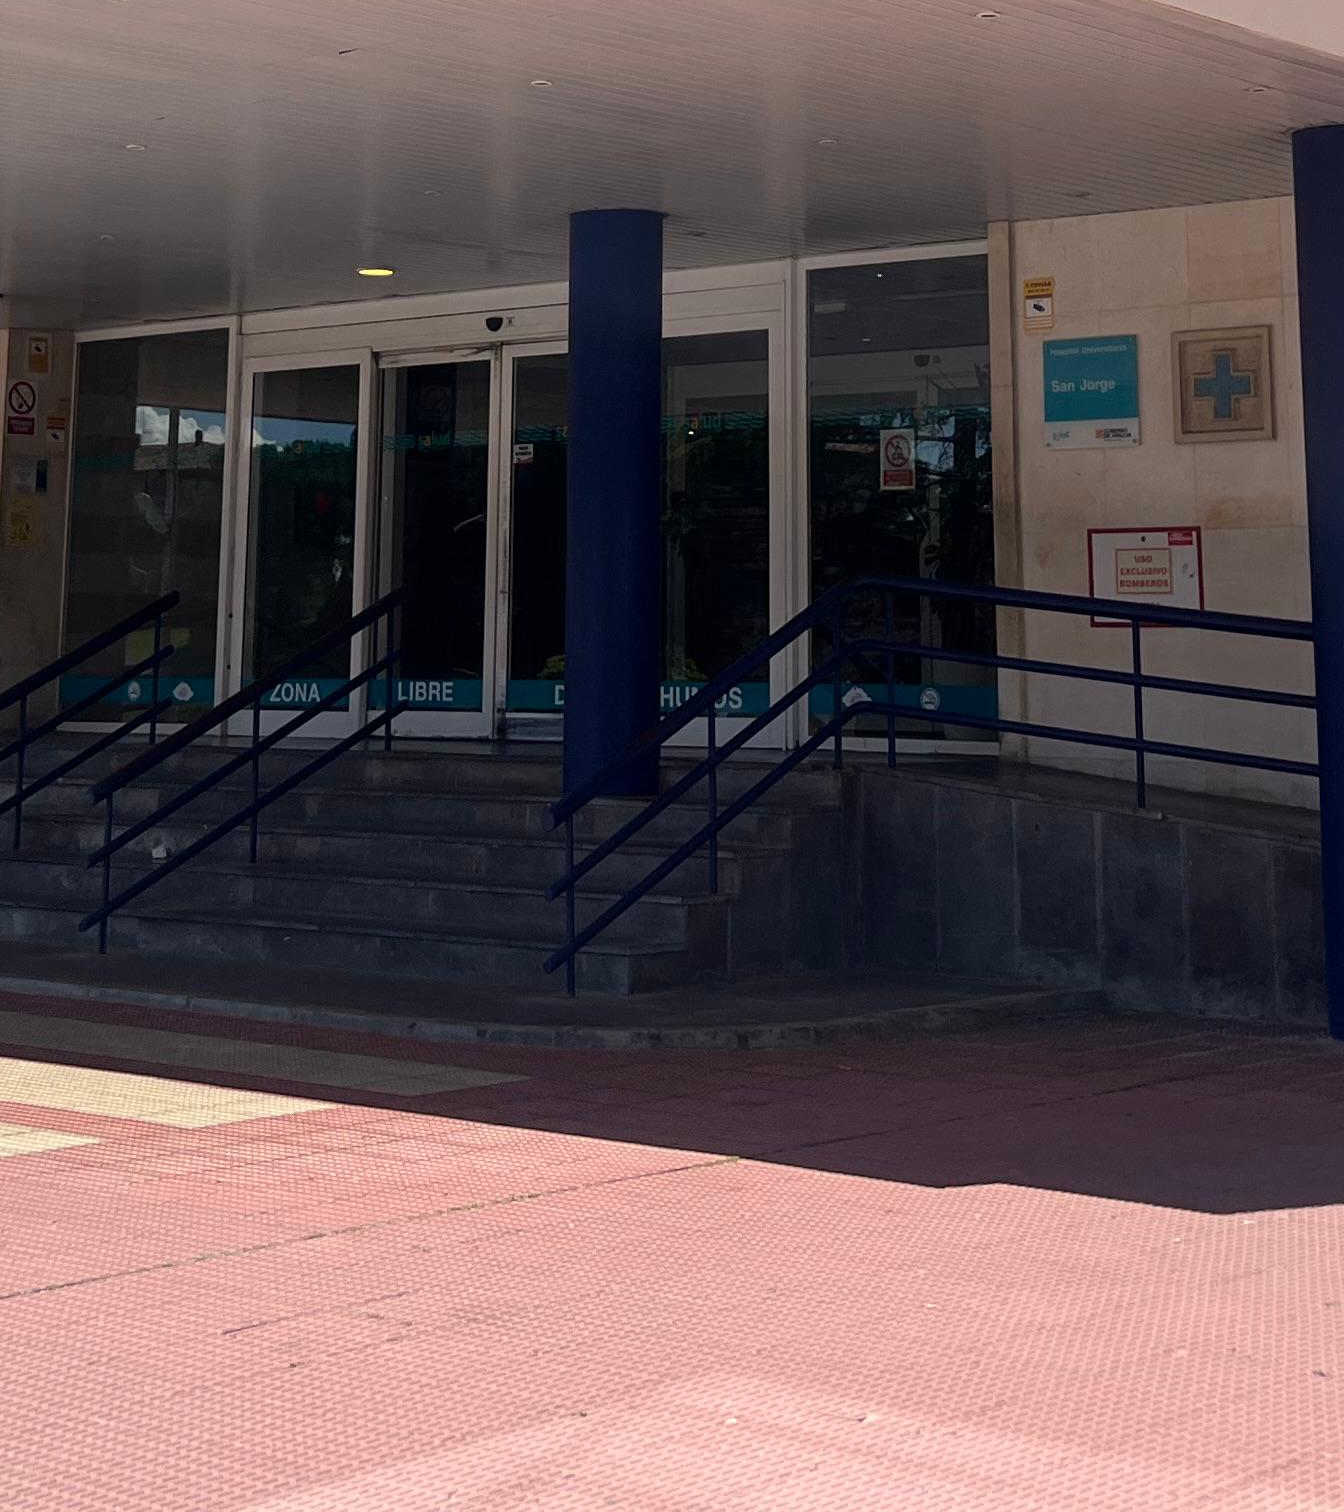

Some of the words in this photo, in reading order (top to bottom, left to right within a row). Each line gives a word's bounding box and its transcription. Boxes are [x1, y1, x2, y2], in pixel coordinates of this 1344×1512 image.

[1050, 380, 1075, 393] San
[1079, 378, 1116, 394] Jorge
[1134, 555, 1153, 564] USO
[1119, 567, 1168, 576] EXCLUSIVO
[1119, 579, 1169, 588] BOMBEROS
[269, 682, 321, 702] ZONA
[398, 681, 454, 701] LIBRE
